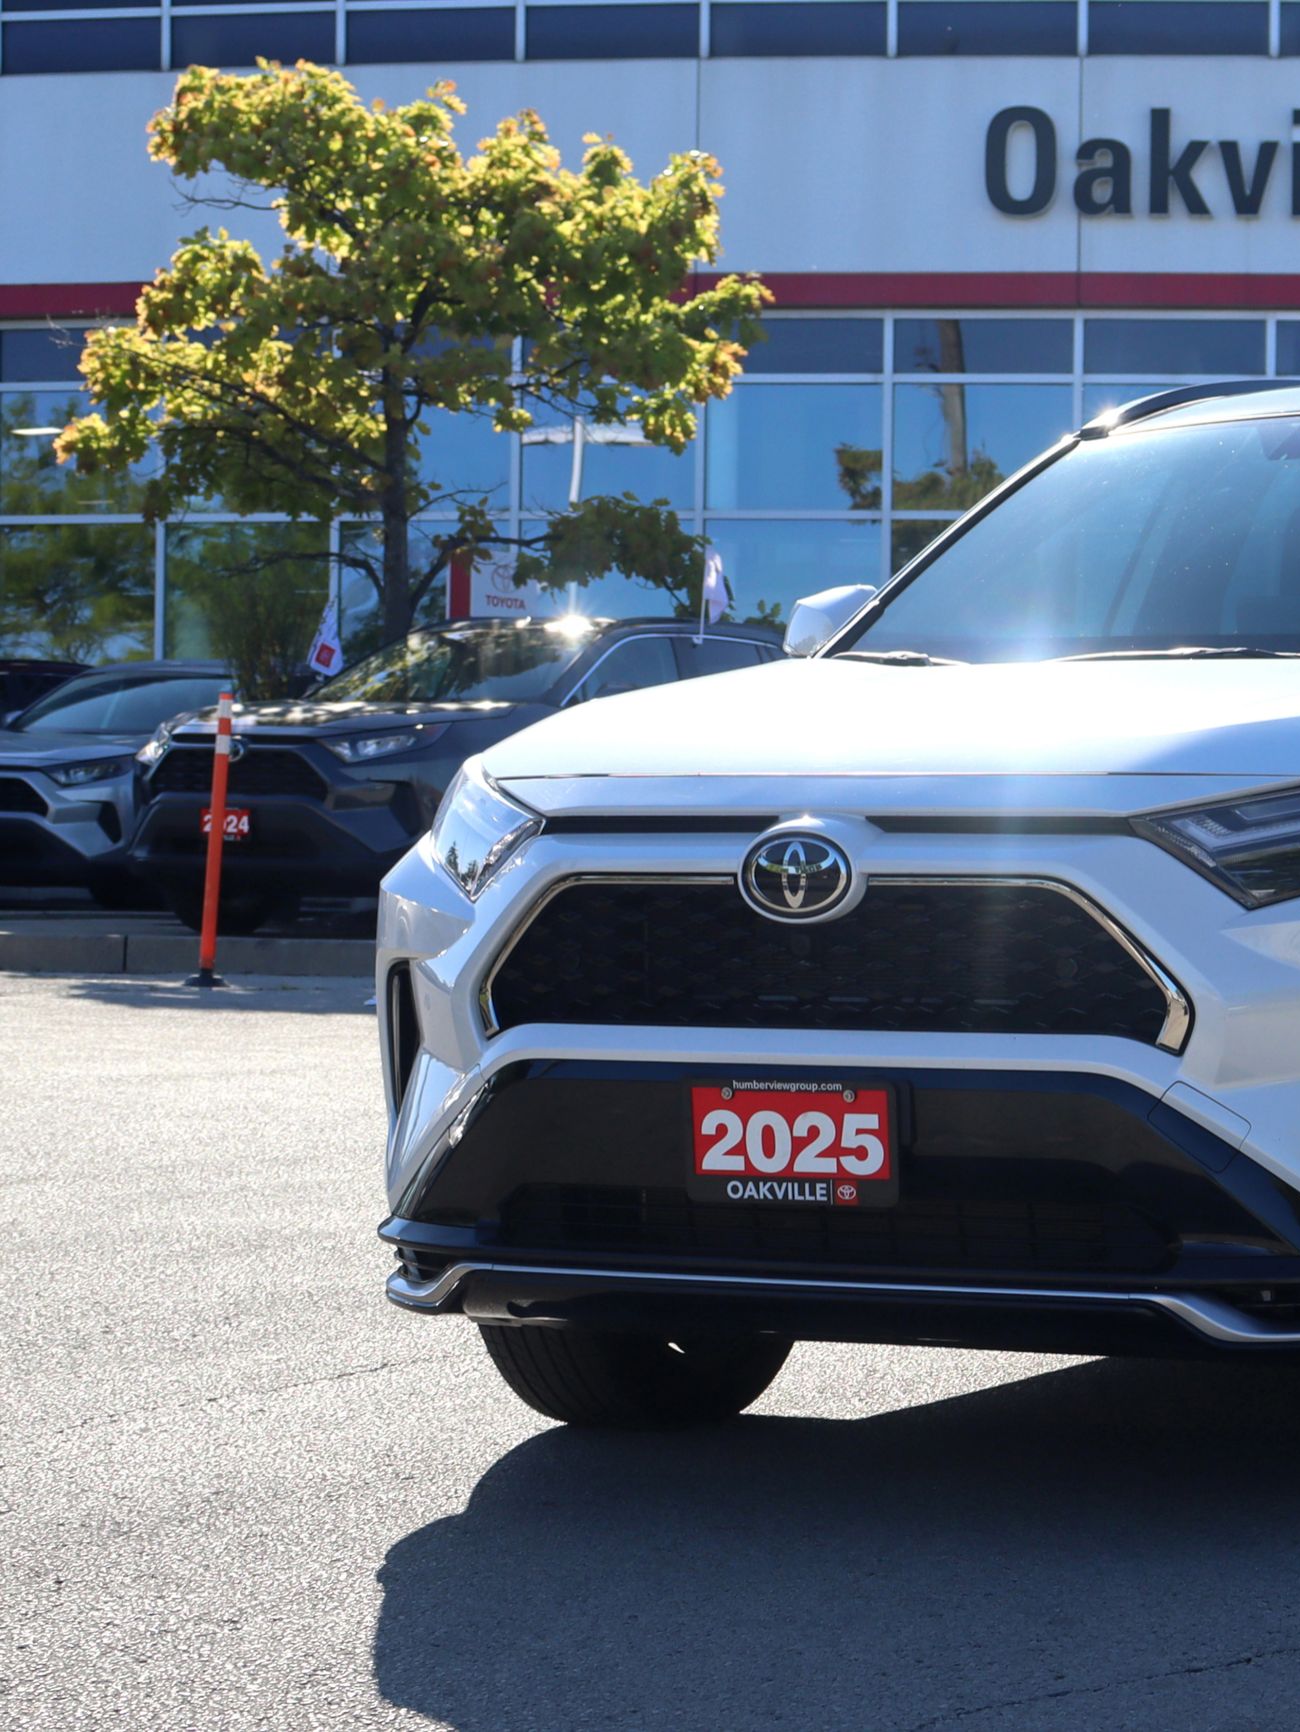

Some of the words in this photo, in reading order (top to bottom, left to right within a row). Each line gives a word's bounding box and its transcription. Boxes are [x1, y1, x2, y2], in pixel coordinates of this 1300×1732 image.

[485, 594, 527, 610] TOYOTA
[732, 1080, 843, 1092] humberviewgroup.com
[701, 1109, 885, 1176] 2025
[727, 1180, 828, 1201] OAKVILLE
